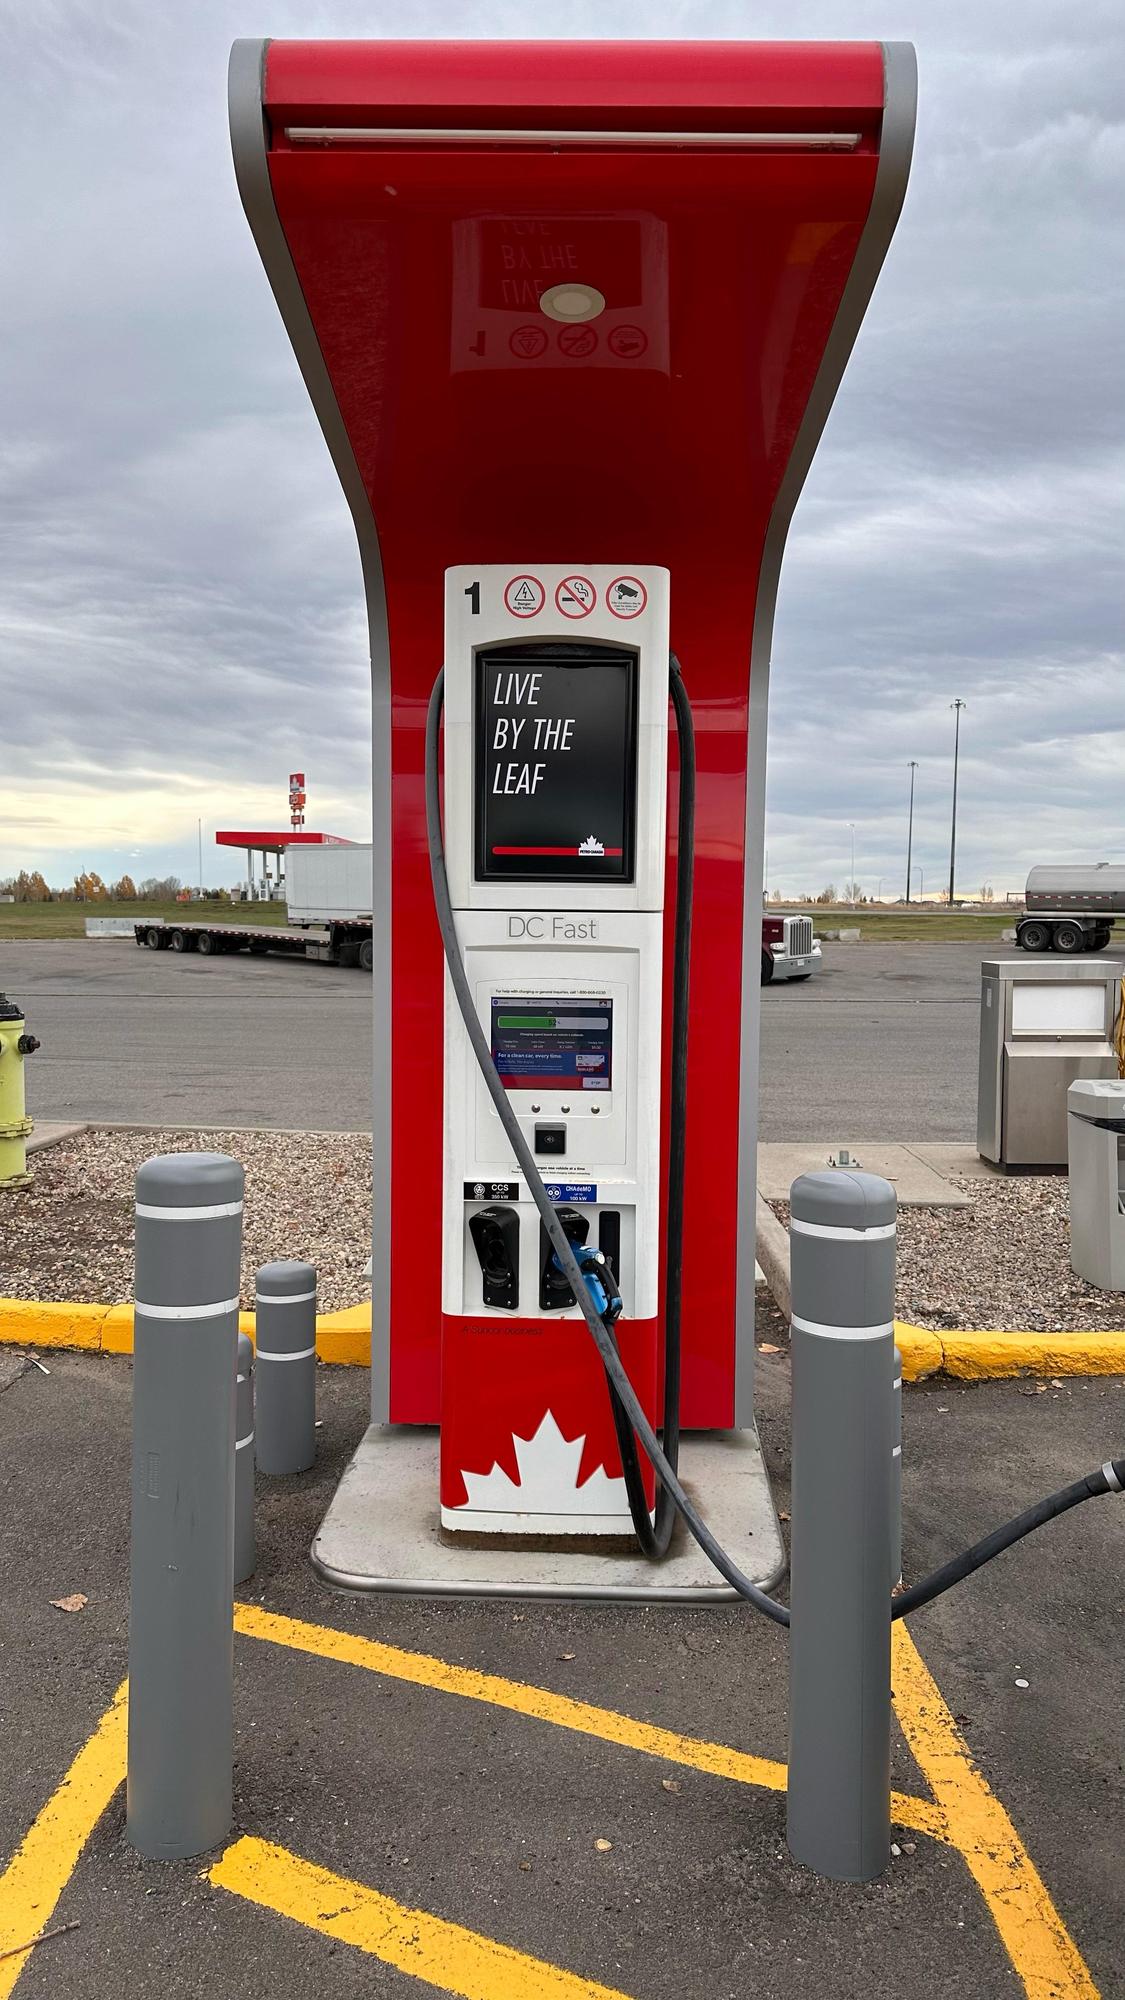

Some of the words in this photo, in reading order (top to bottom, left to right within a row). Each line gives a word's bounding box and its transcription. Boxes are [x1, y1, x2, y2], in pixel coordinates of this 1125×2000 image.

[464, 581, 481, 615] 1
[493, 673, 543, 705] LIVE
[492, 718, 526, 750] BY
[533, 718, 576, 751] THE
[492, 763, 546, 794] LEAF
[508, 916, 544, 938] DC
[552, 917, 597, 939] Fast
